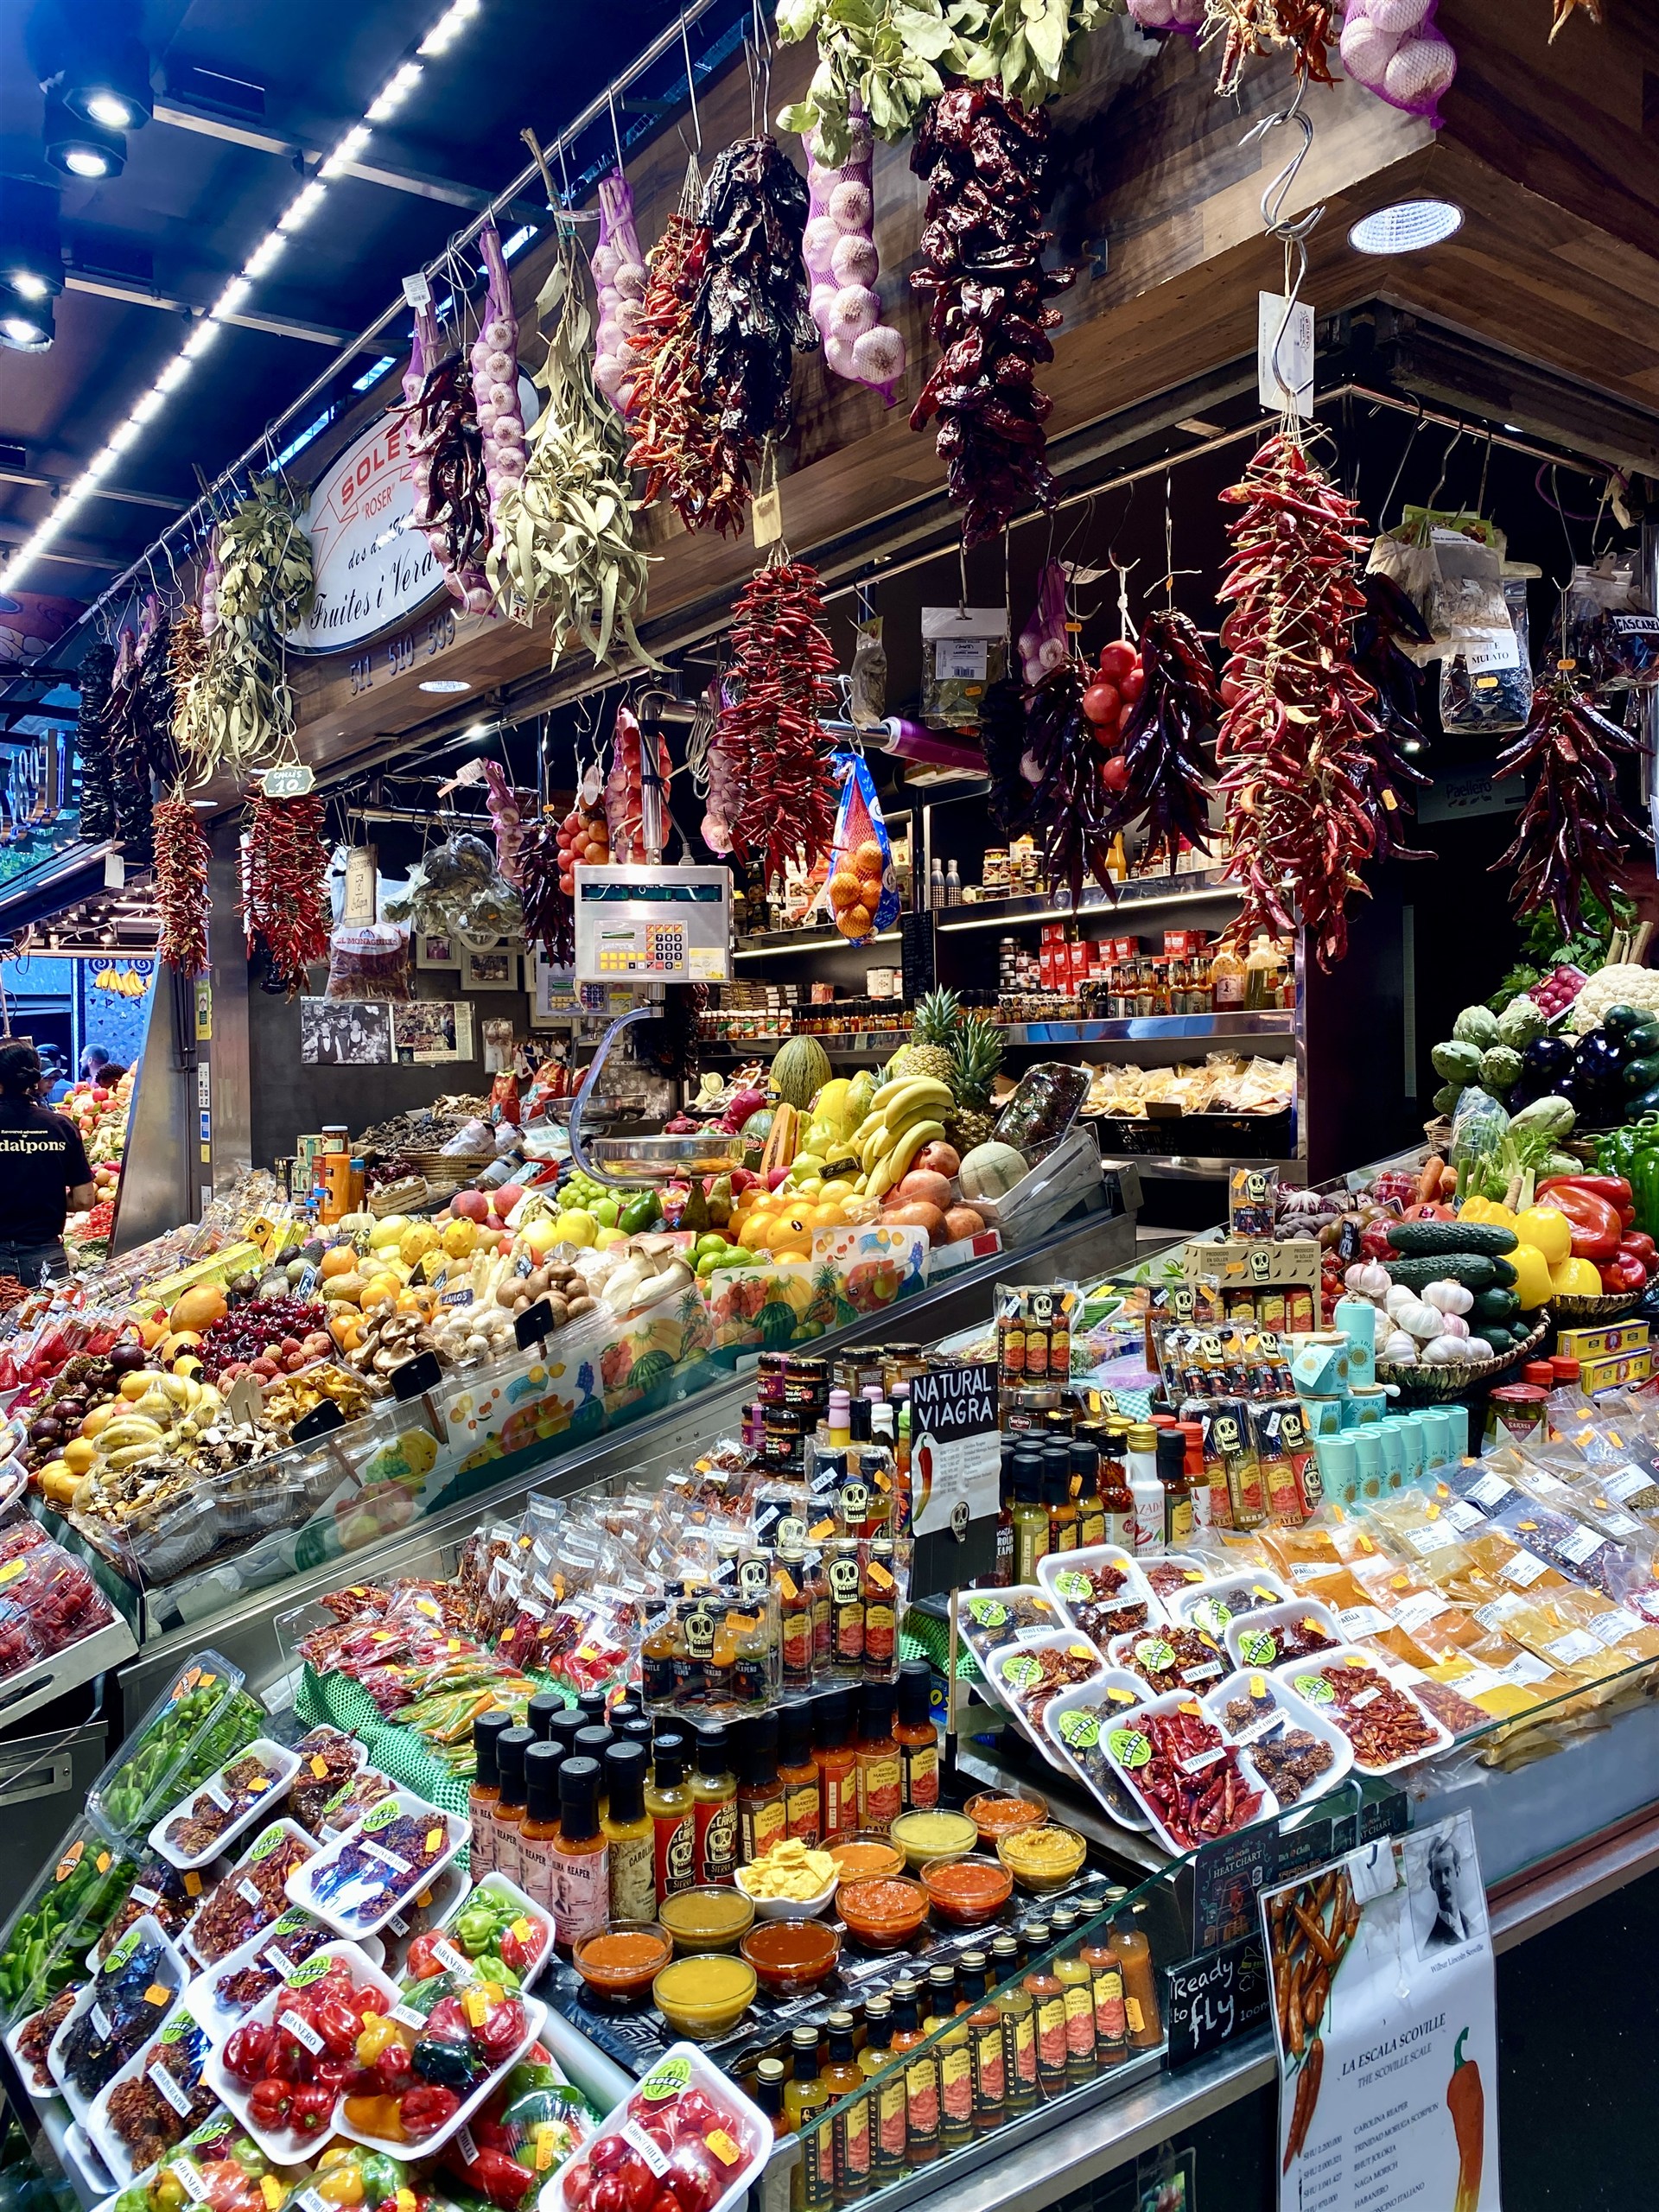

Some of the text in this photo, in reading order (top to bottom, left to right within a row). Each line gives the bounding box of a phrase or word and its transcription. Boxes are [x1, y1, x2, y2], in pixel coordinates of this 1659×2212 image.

[341, 429, 410, 506] SOLE
[310, 588, 370, 630] Fruites
[427, 612, 456, 655] 509
[388, 632, 415, 676] 510
[349, 655, 373, 696] 511
[913, 1366, 992, 1404] NATURAL
[918, 1395, 994, 1431] VIAGRA
[814, 1472, 831, 1489] PACK
[754, 1513, 774, 1532] PACK
[712, 1565, 731, 1580] PACK
[645, 1618, 666, 1634] PACK
[1149, 1642, 1166, 1668] SOLEY
[1249, 1637, 1269, 1661] SOLEY
[1017, 1659, 1033, 1684] SOLEY
[1185, 1670, 1198, 1681] MIX
[1071, 1717, 1094, 1743] SOLEY
[1123, 1733, 1142, 1764] SOLEY
[480, 1809, 492, 1820] REA
[1369, 1819, 1392, 1835] CHART
[497, 1828, 517, 1847] REAPER
[524, 1850, 546, 1866] REAPER
[1212, 1849, 1263, 1879] HEAT CHART
[567, 1866, 591, 1879] REAPER
[1430, 1943, 1484, 1974] Wilbur Lincoln Scoville
[1173, 1955, 1233, 2000] Ready
[1173, 2007, 1188, 2024] to
[1342, 2012, 1446, 2076] LA ESCALA SCOVILLE
[1005, 2029, 1016, 2095] SCORPION
[1357, 2043, 1433, 2088] THE SCOVILLE SCALE
[648, 2077, 684, 2088] SOLEY
[1353, 2101, 1409, 2135] CAROLINA REAPER
[1354, 2133, 1384, 2154] TRINIDAD
[1410, 2101, 1440, 2124] SCORPION
[808, 2131, 817, 2202] SCORPIO
[1303, 2148, 1318, 2162] SHU
[1353, 2144, 1397, 2172] BHUT JOLOKIA
[1303, 2166, 1318, 2180] SHU
[1353, 2160, 1399, 2191] NAGA MORICH
[1303, 2185, 1318, 2199] SHU
[1353, 2183, 1389, 2209] HABANERO
[1396, 2182, 1426, 2204] ITALIANO
